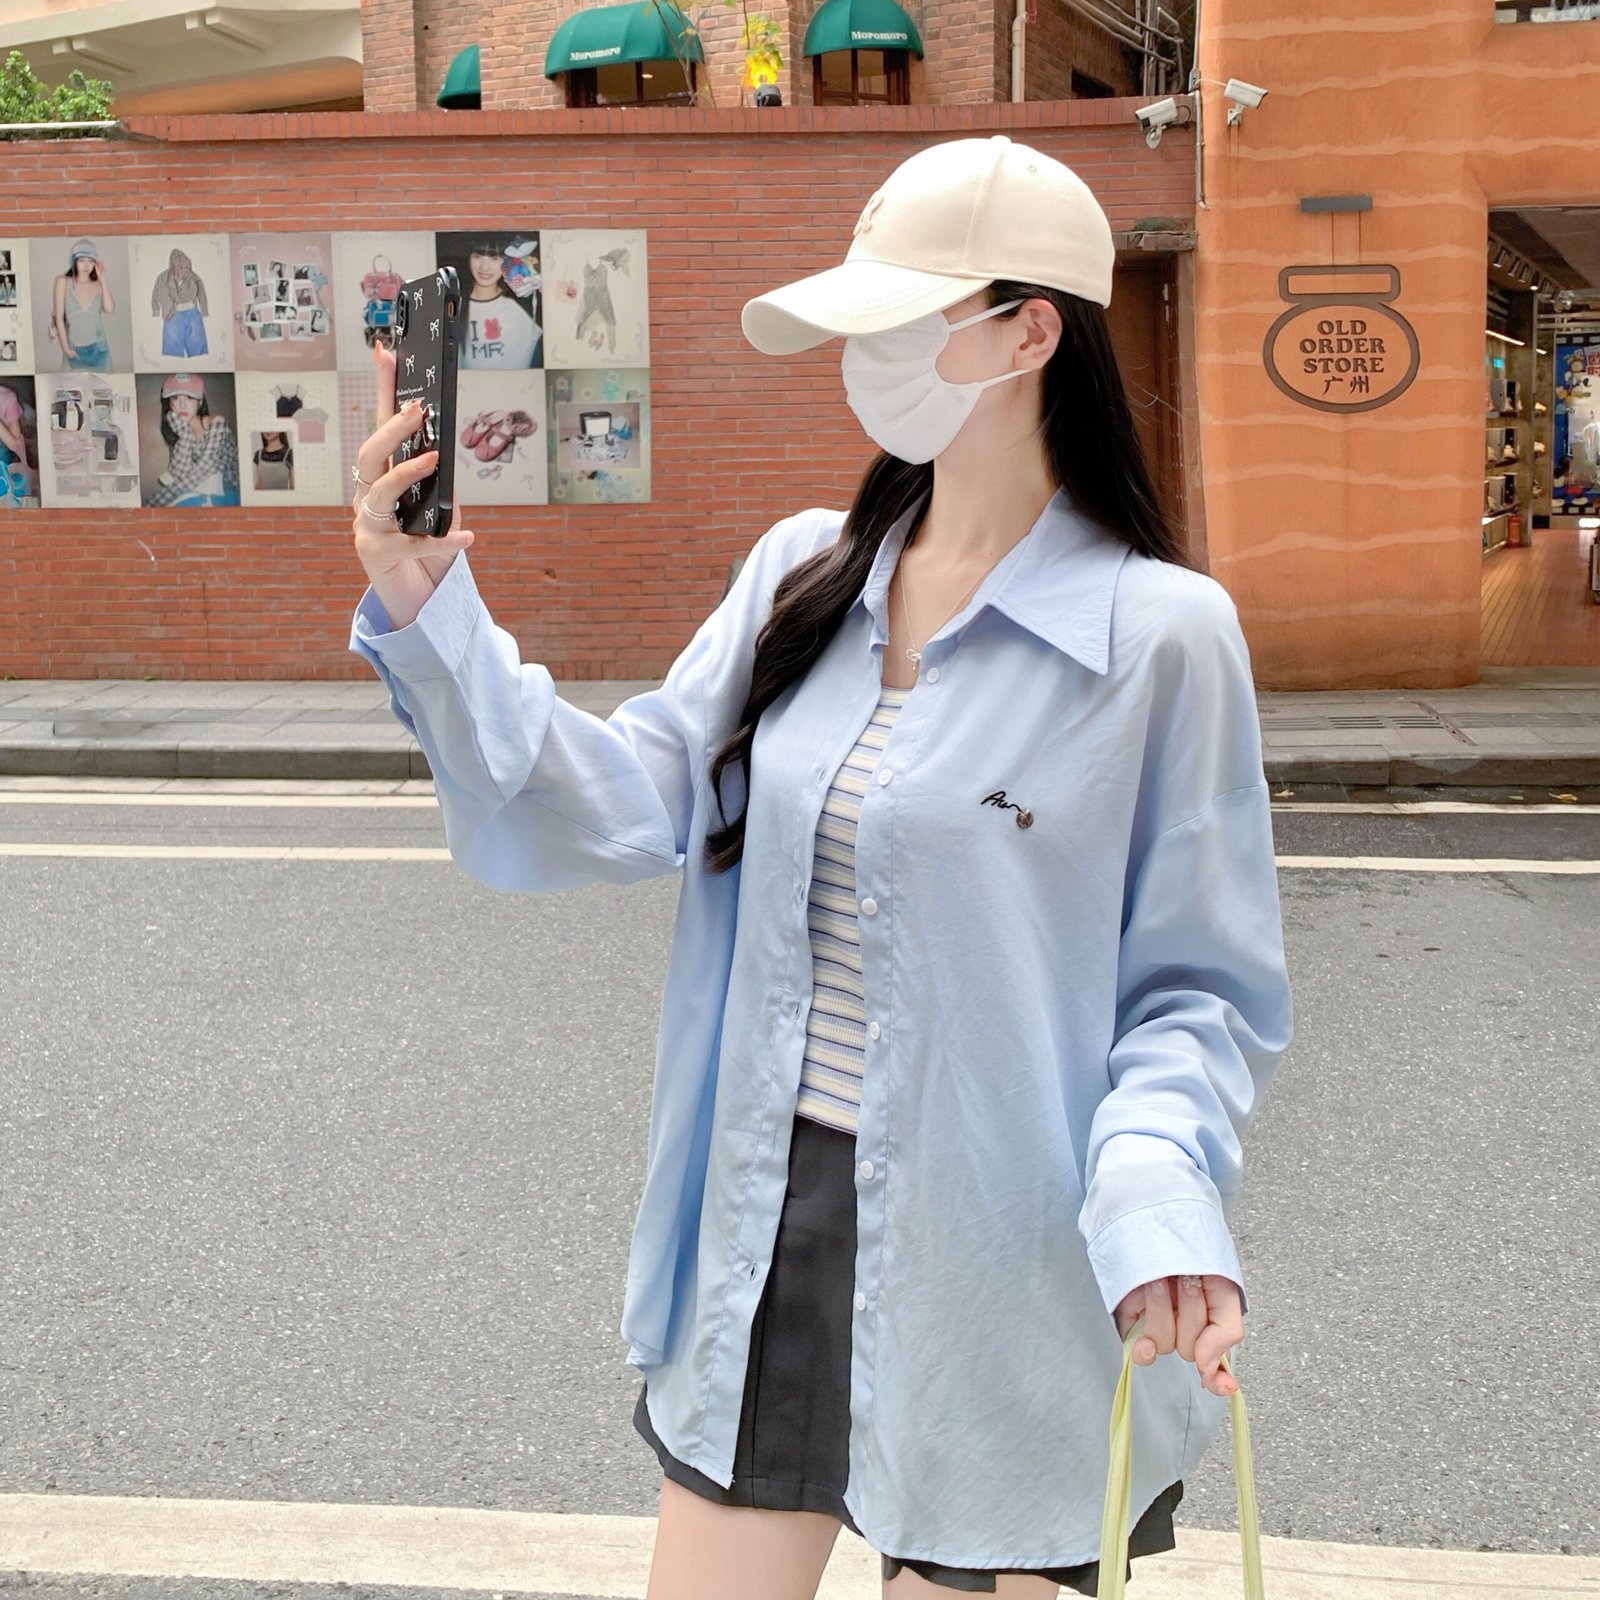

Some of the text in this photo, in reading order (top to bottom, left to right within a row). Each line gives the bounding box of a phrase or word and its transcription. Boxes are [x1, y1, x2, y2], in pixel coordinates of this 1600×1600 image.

[851, 31, 908, 41] Moromoro
[569, 46, 621, 61] Moromoro
[1317, 320, 1367, 336] OLD
[1299, 338, 1386, 354] ORDER
[1303, 358, 1385, 374] STORE
[1322, 375, 1370, 395] 广州
